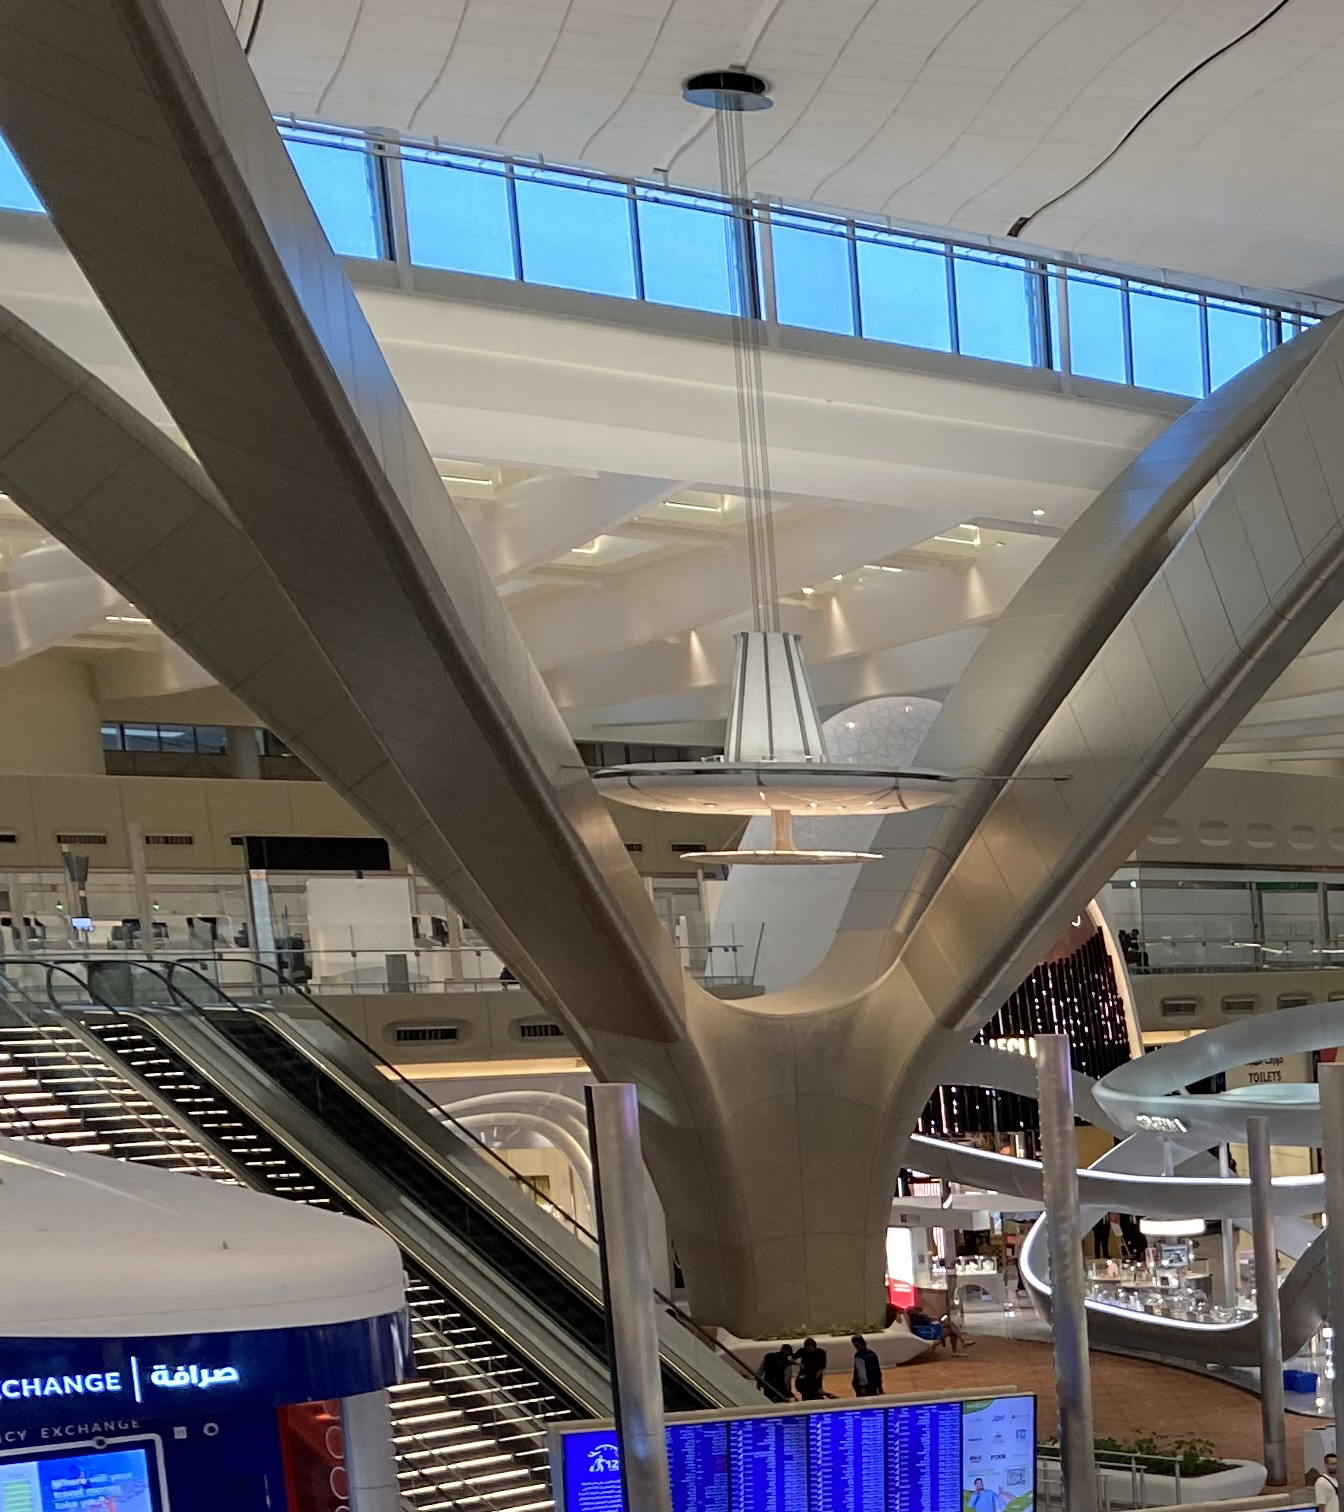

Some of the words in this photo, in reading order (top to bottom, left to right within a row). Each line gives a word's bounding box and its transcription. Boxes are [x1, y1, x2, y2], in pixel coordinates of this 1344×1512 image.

[1248, 1070, 1282, 1083] TOILETS
[0, 1371, 122, 1400] CHANGE
[150, 1364, 240, 1390] صرافة
[40, 1420, 141, 1439] EXCHANGE
